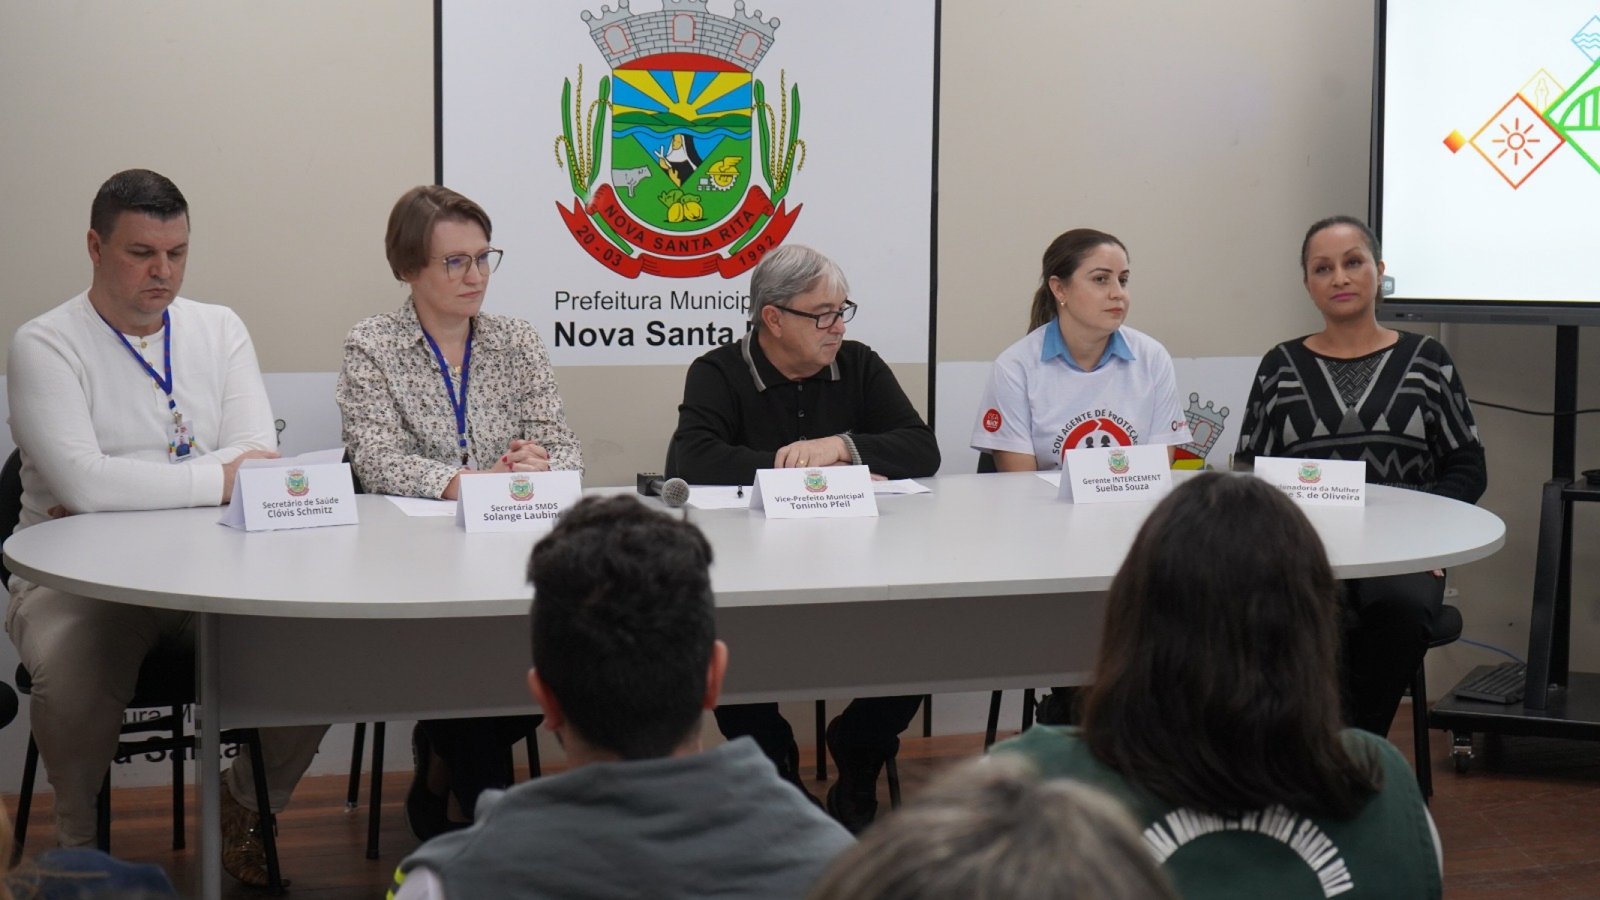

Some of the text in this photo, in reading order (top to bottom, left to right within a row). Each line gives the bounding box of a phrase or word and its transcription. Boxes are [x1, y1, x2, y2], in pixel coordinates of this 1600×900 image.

[604, 203, 755, 253] NOVA SANTA RITA
[737, 234, 776, 267] 1992
[555, 290, 751, 315] Prefeitura Municip
[554, 321, 635, 347] Nova
[645, 320, 734, 347] Santa
[1052, 435, 1064, 455] SOU
[1062, 411, 1093, 436] AGENTE
[1094, 408, 1107, 418] DE
[1112, 474, 1161, 483] INTERCEMENT
[1095, 483, 1149, 493] Suelba Souza
[774, 492, 865, 503] Vice-Prefeito Municipal
[1321, 492, 1360, 501] Oliveira
[262, 497, 339, 509] Secretário de Saúde
[490, 502, 559, 512] Secretária SMDS
[789, 500, 851, 510] Toninho Pfeil
[267, 505, 333, 518] Clóvis Schmitz
[483, 512, 522, 523] Solange
[1289, 818, 1339, 872] SANTA
[1317, 857, 1354, 899] RITA
